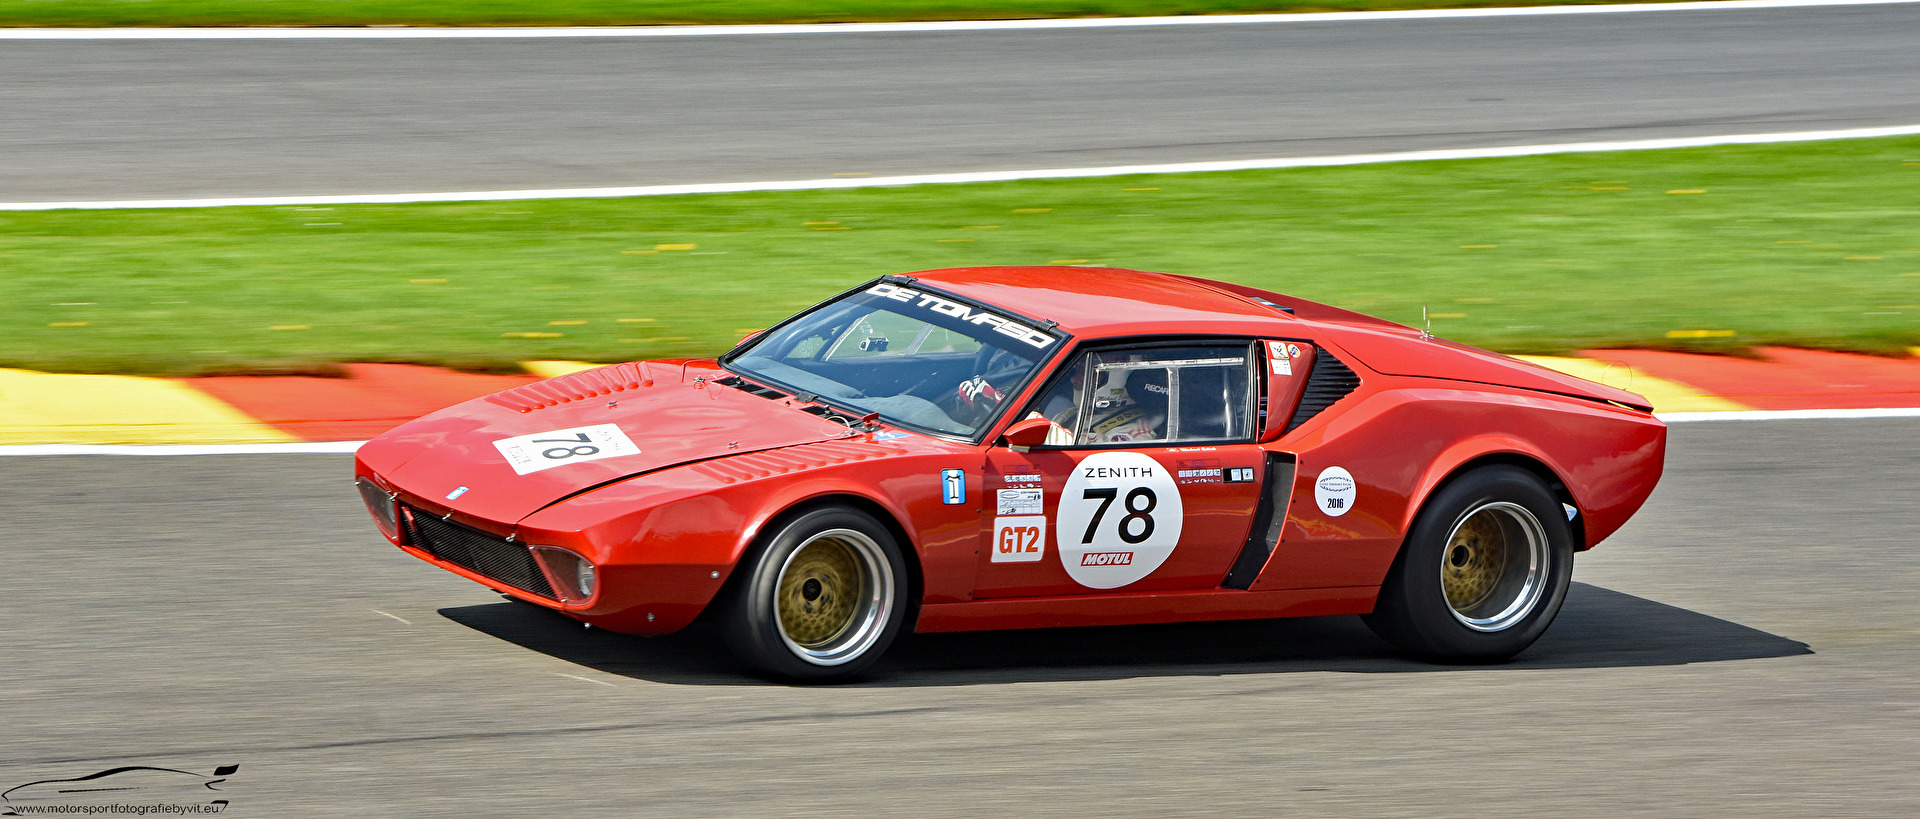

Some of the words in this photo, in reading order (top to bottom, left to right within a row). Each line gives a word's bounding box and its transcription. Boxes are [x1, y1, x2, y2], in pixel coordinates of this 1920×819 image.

[865, 283, 920, 303] DE
[917, 293, 1056, 349] TOMASO
[1144, 383, 1169, 395] RECAR
[531, 433, 600, 459] 78
[1084, 467, 1153, 478] ZENITH
[1327, 497, 1344, 509] 2016
[1081, 486, 1157, 544] 78
[999, 526, 1040, 554] GT2
[1082, 553, 1131, 565] MOTUL
